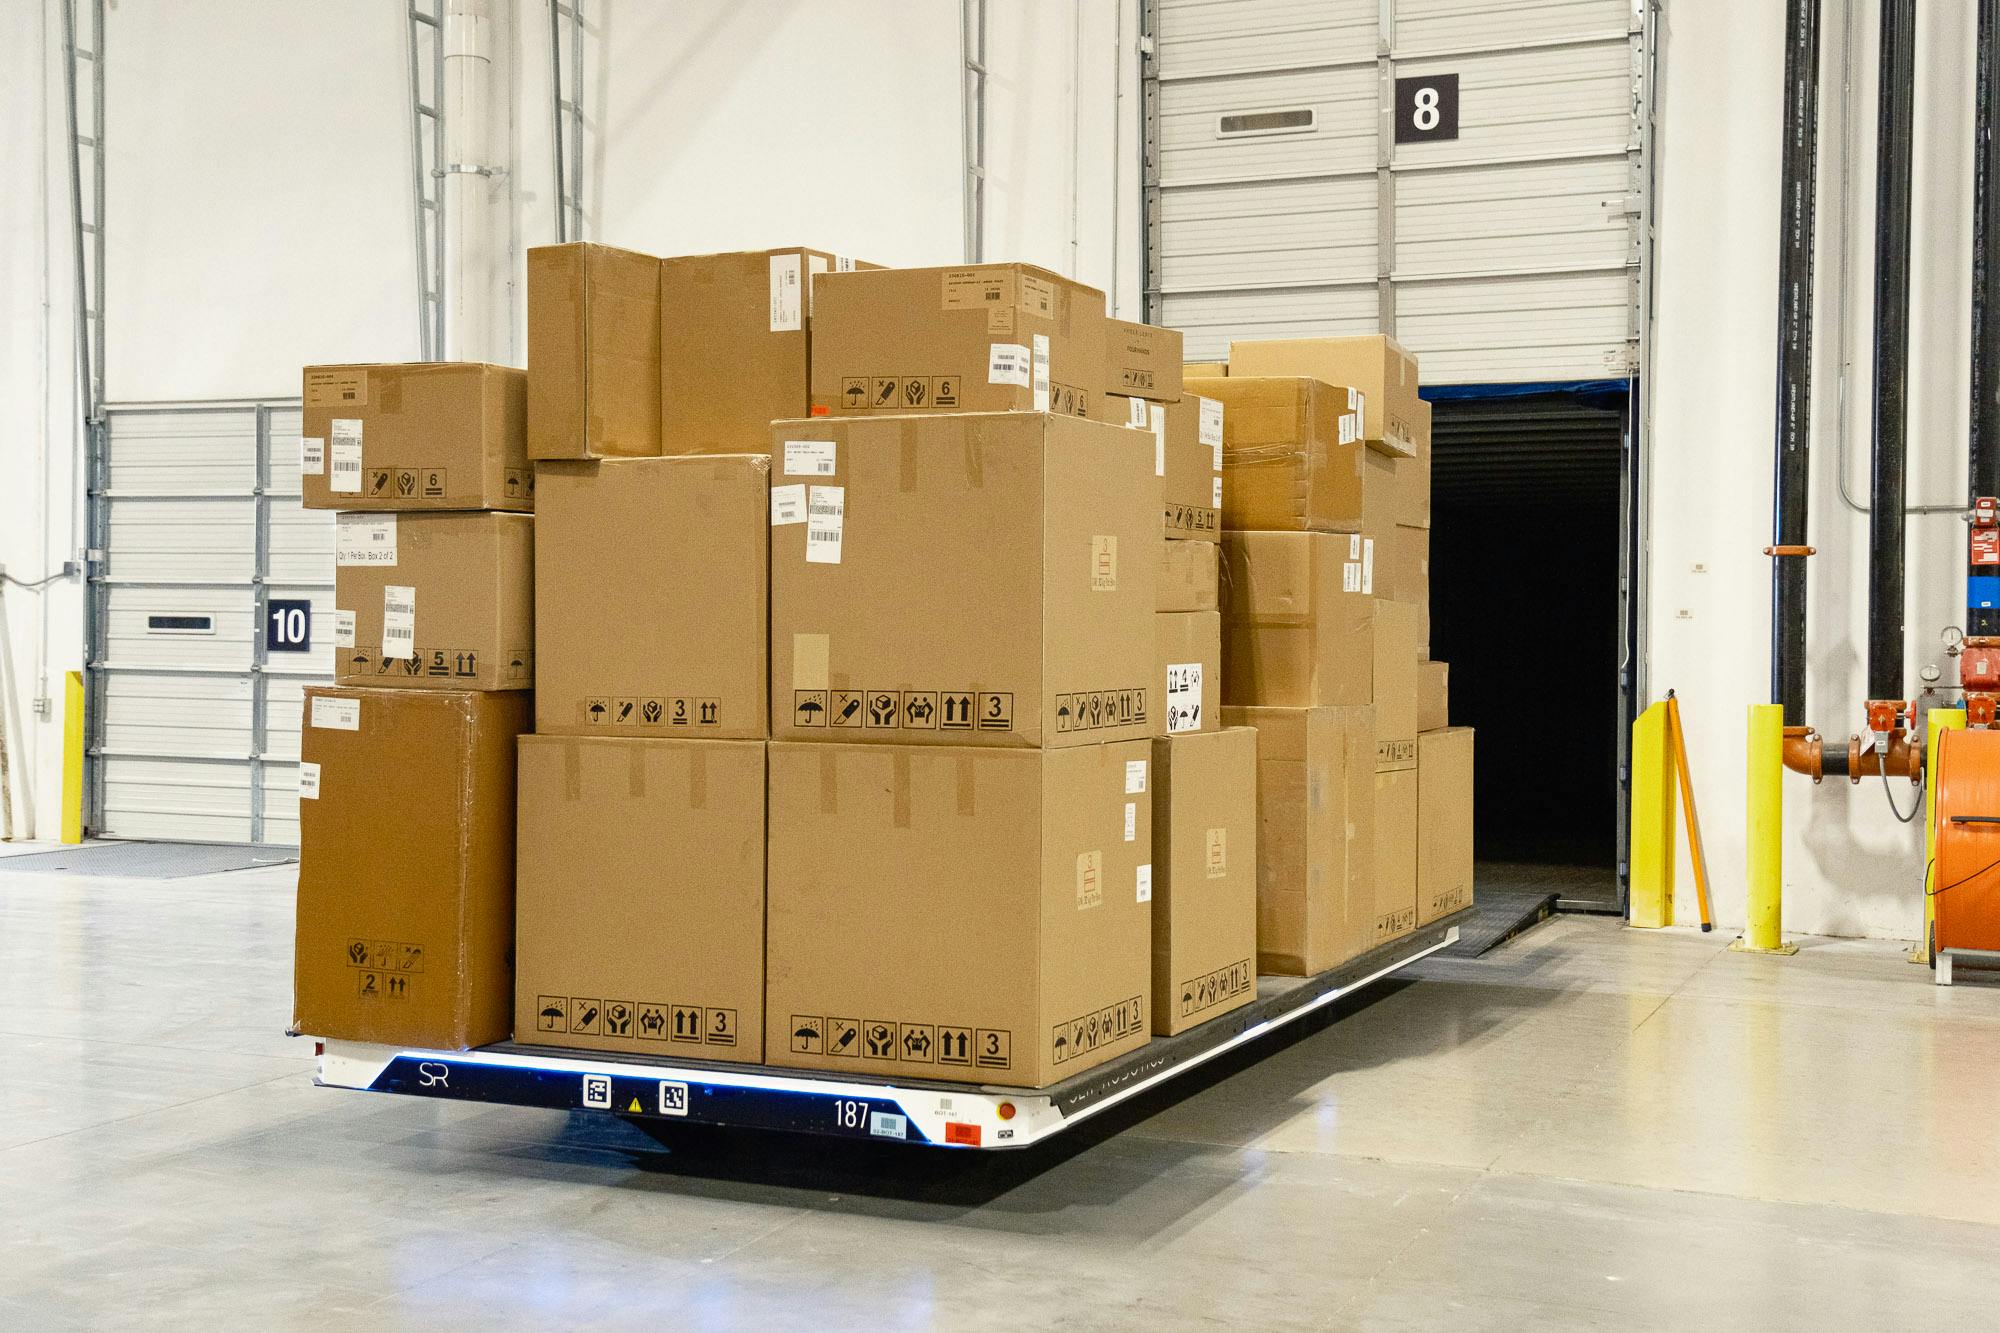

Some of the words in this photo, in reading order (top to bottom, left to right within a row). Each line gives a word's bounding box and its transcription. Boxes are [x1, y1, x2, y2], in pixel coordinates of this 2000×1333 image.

[1414, 88, 1440, 130] 8
[941, 382, 951, 396] 6
[1078, 394, 1084, 409] 6
[429, 474, 437, 487] 6
[1196, 513, 1203, 527] 5
[368, 551, 378, 560] Box
[379, 551, 383, 560] 2
[384, 551, 389, 560] of
[390, 551, 394, 560] 2
[272, 609, 305, 644] 10
[433, 651, 444, 667] 5
[1179, 669, 1189, 688] 4
[675, 699, 686, 717] 3
[989, 696, 1001, 718] 3
[1137, 692, 1143, 712] 3
[1243, 962, 1248, 977] 3
[365, 974, 376, 991] 2
[1132, 1000, 1139, 1019] 3
[715, 1011, 727, 1033] 3
[986, 1032, 1000, 1055] 3
[419, 1063, 449, 1088] SR
[834, 1099, 869, 1129] 187
